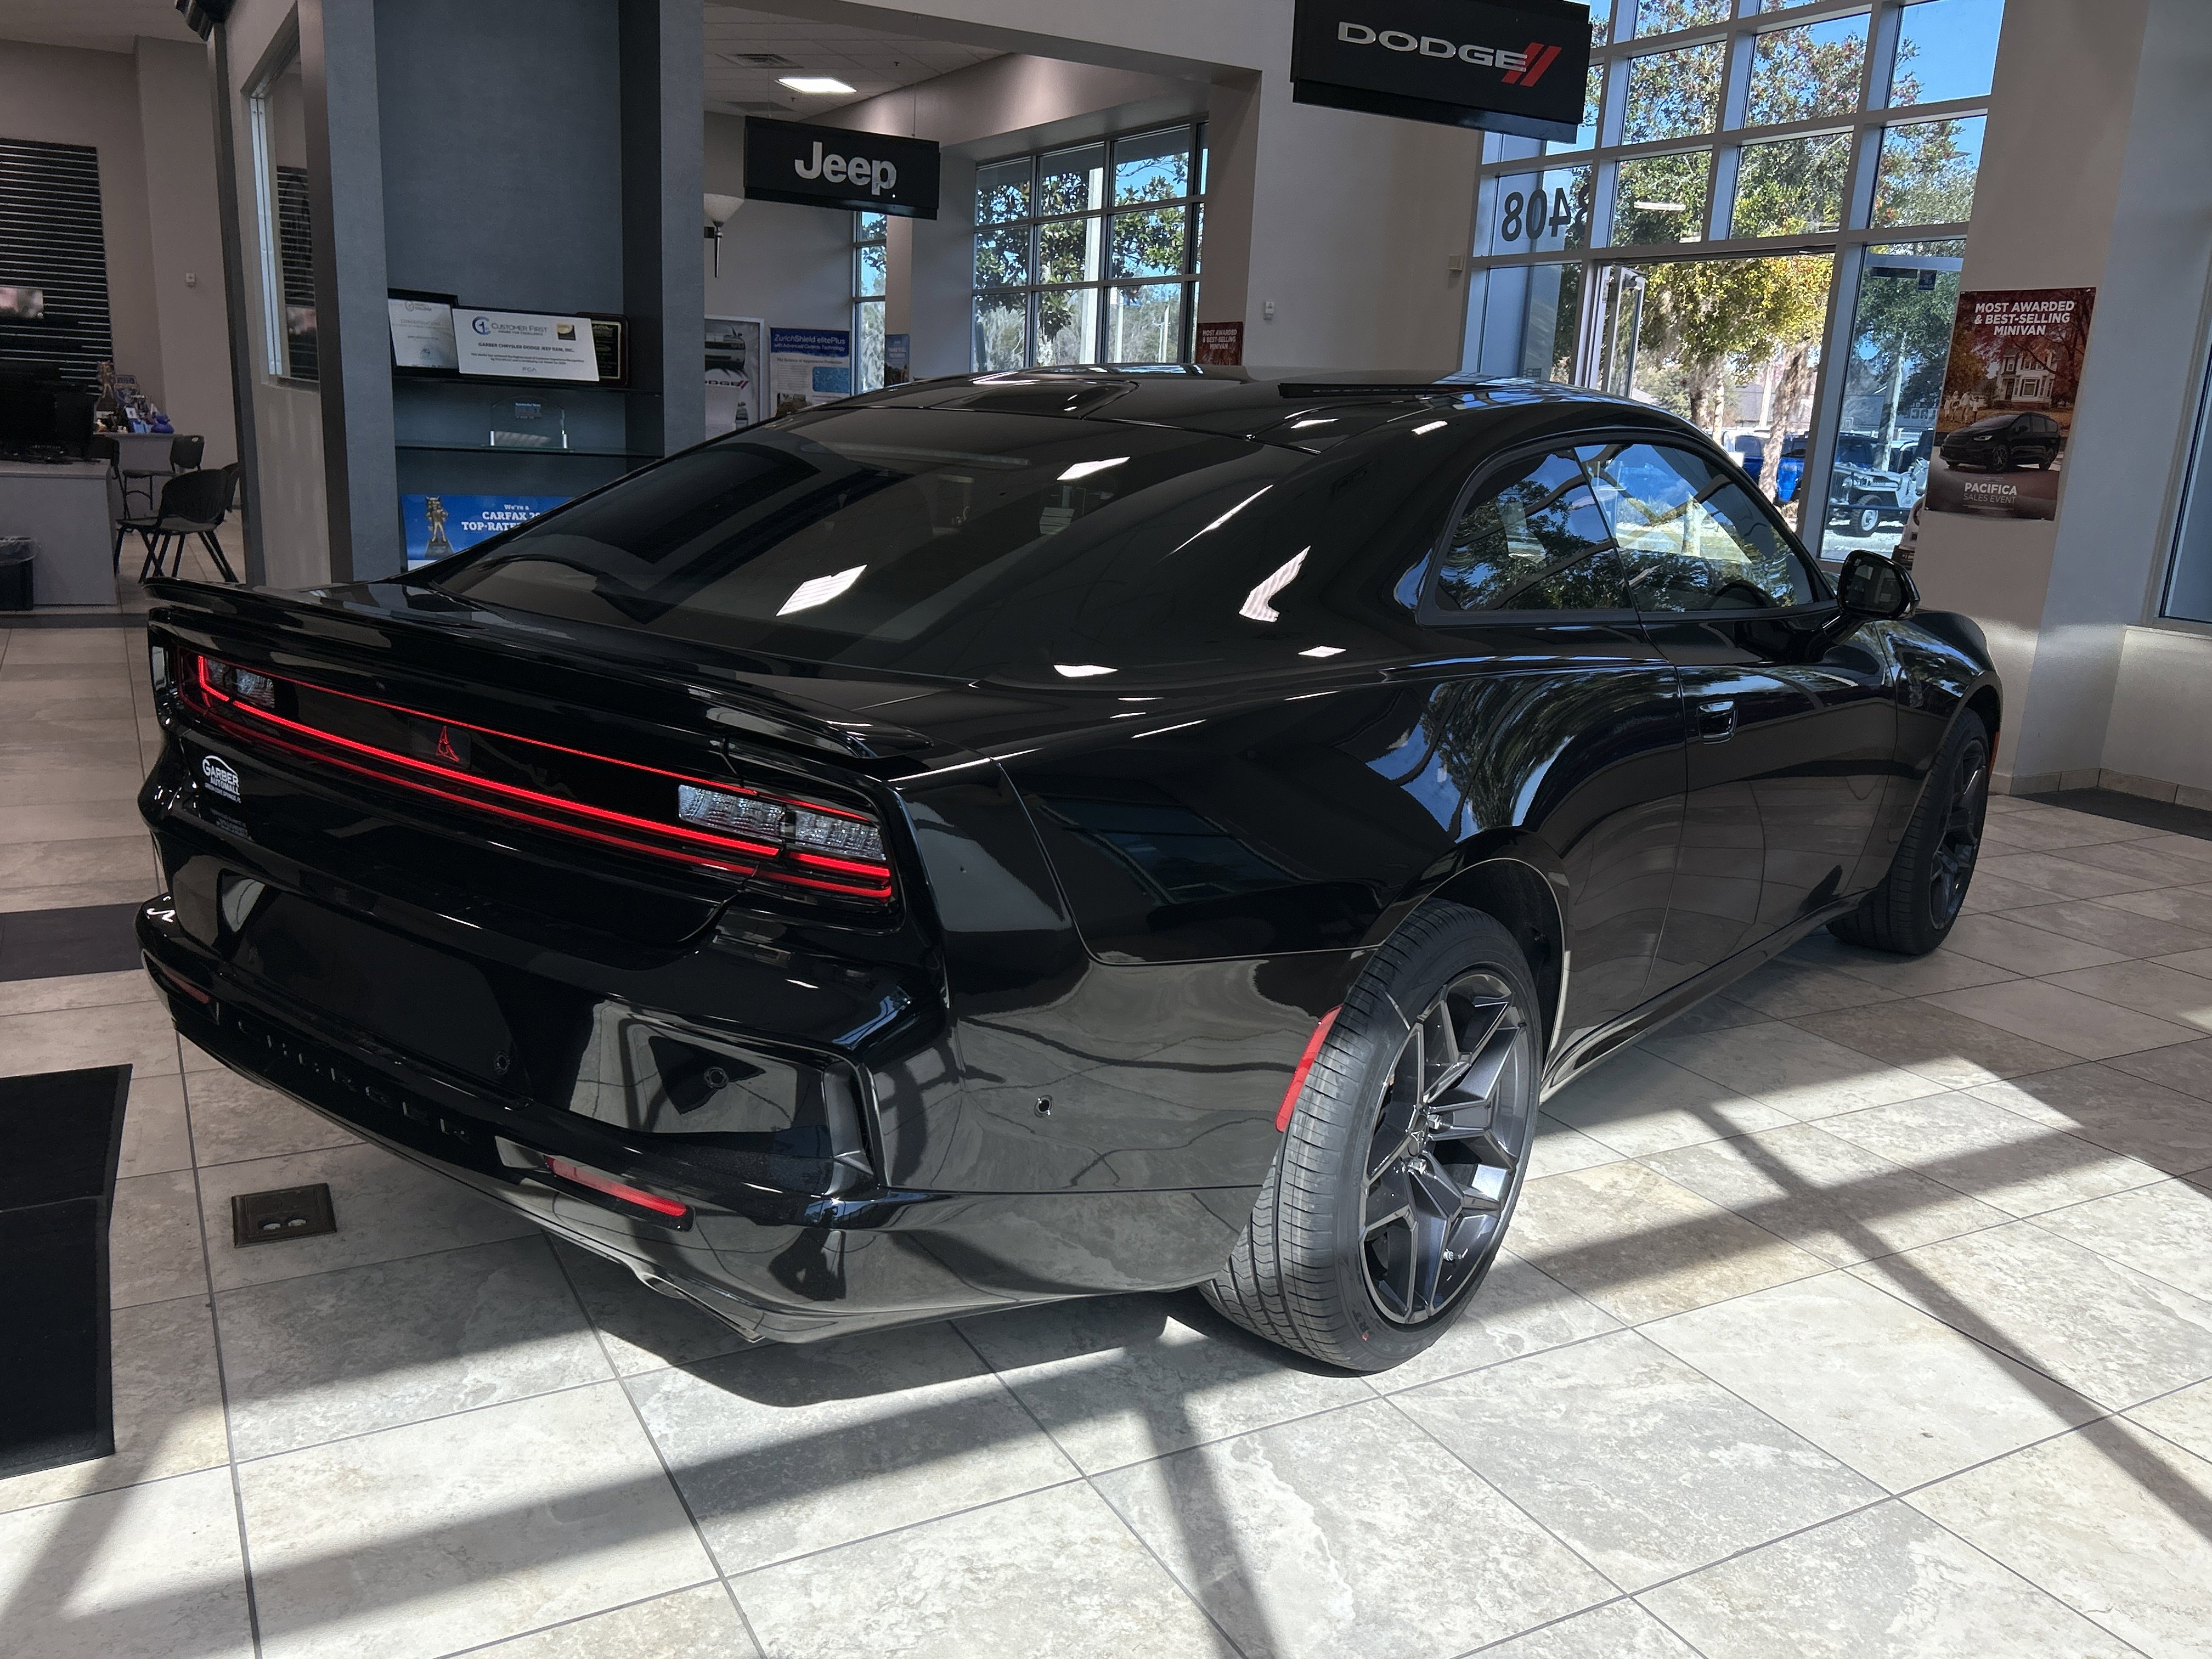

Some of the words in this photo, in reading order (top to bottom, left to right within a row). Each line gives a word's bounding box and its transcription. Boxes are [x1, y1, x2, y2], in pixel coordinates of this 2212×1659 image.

[1337, 21, 1528, 72] DODGE
[794, 141, 898, 196] Jeep
[1974, 302, 2009, 313] MOST
[2011, 300, 2075, 313] AWARDED
[1974, 314, 1983, 324] &
[1985, 313, 2070, 324] BEST-SELLING
[1994, 325, 2046, 336] MINIVAN
[774, 334, 816, 343] ZurichShield
[1964, 482, 2017, 495] PACIFICA
[1963, 493, 1988, 502] SALES
[1989, 495, 2017, 504] EVENT
[482, 511, 527, 521] CARFAX
[461, 522, 521, 531] TOP-RATE
[202, 759, 240, 788] GARBER
[210, 775, 240, 795] AUTOMALL
